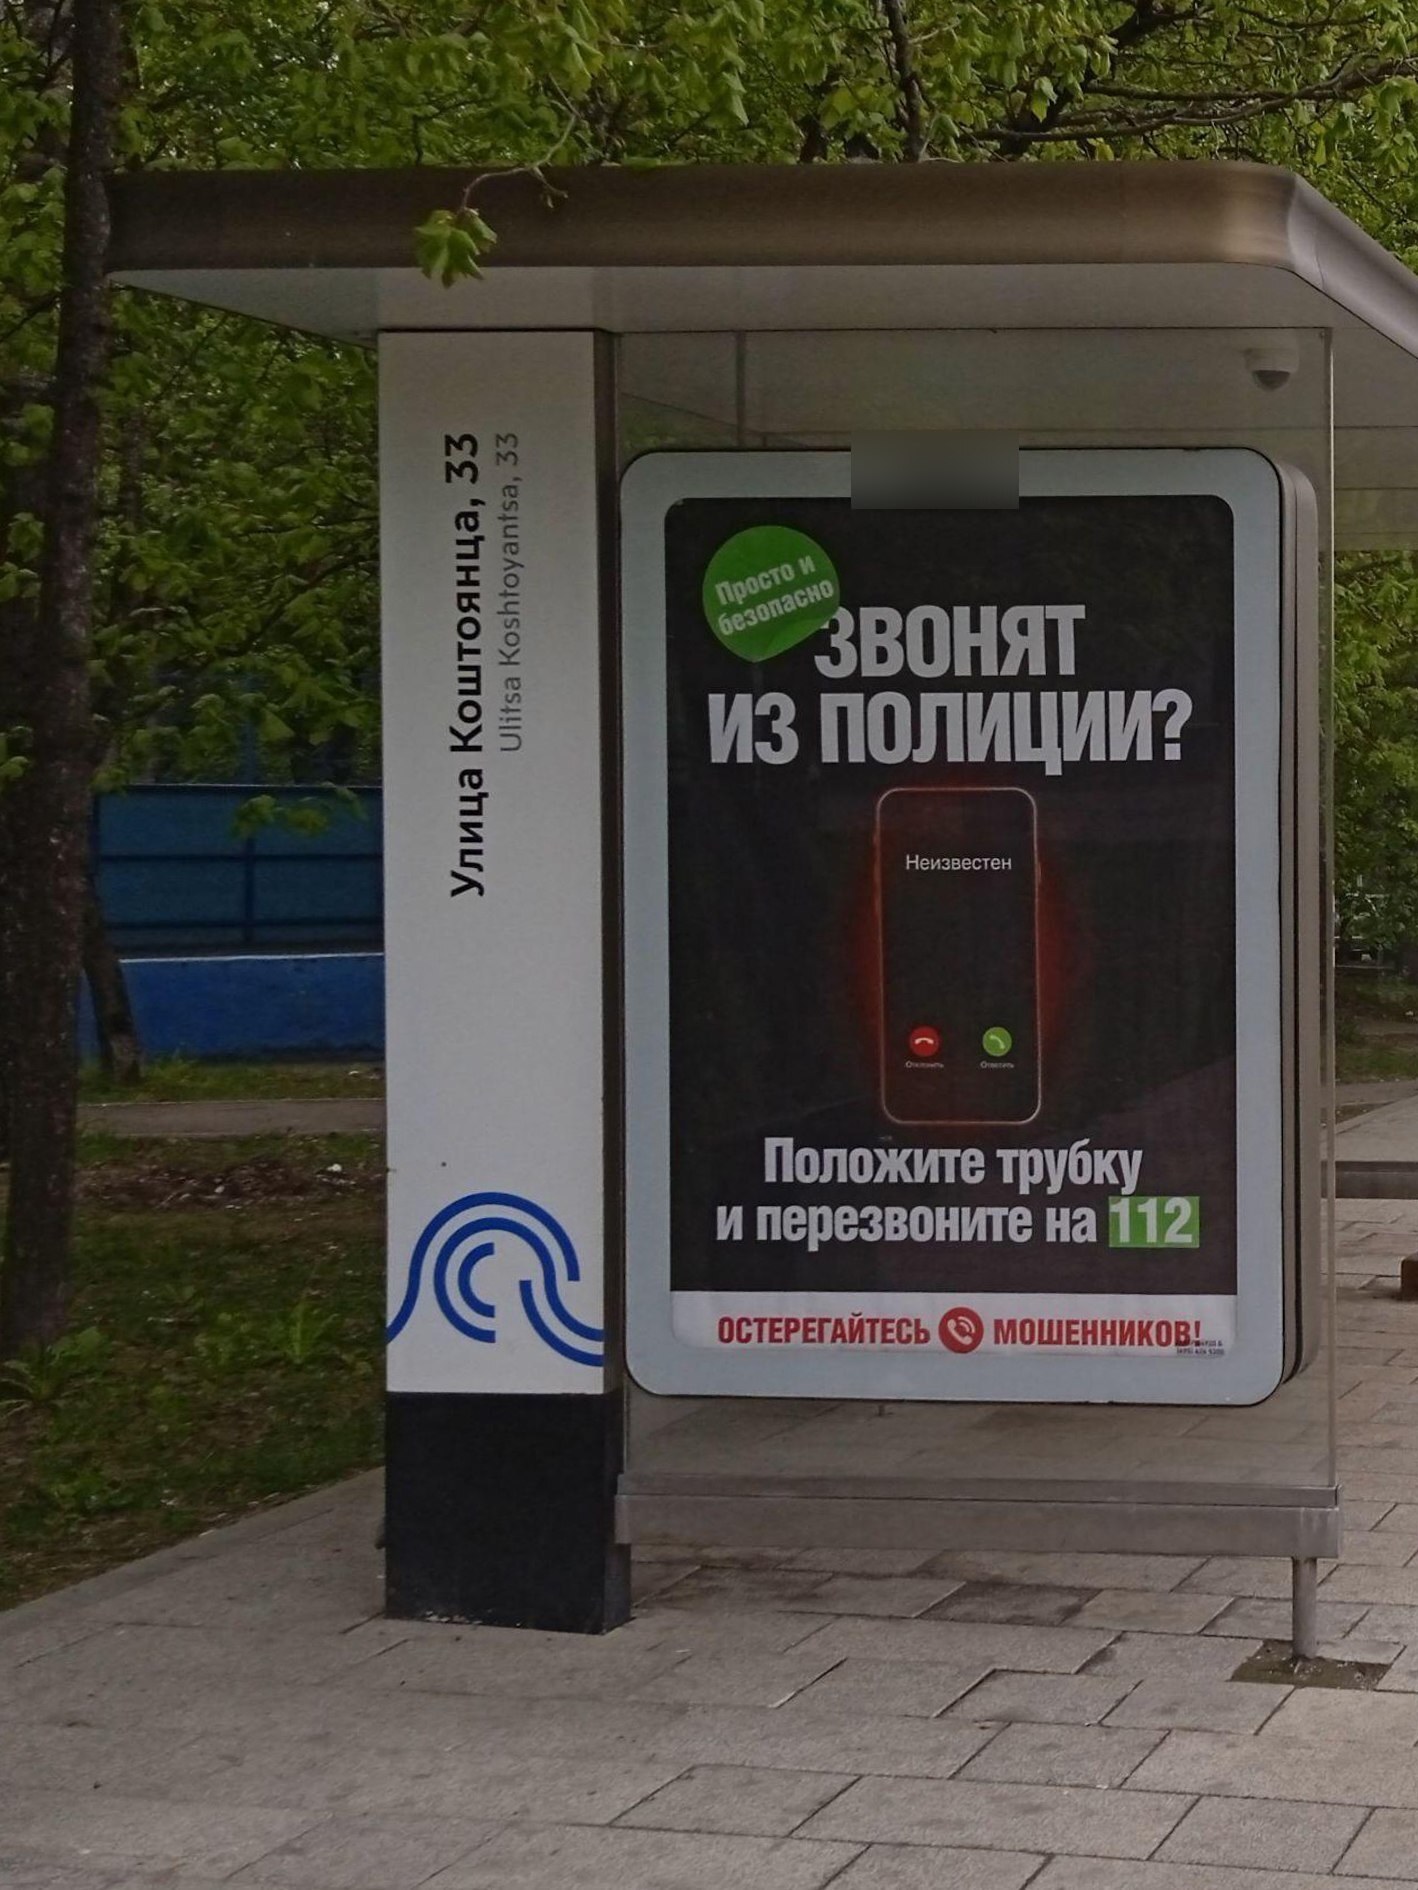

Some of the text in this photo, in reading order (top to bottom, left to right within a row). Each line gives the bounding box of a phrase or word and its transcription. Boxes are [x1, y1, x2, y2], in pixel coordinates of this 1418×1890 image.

[495, 432, 525, 752] Ulitsa Koshtoyantsa, 33
[715, 555, 816, 606] Просто и
[717, 580, 834, 635] безопасно
[445, 433, 489, 898] Улица Коштоянца, 33
[813, 604, 1086, 678] ЗВОНЯТ
[707, 688, 1193, 775] ИЗ ПОЛИЦИИ?
[905, 854, 1012, 871] Неизвестен
[764, 1137, 1143, 1196] Положите трубку
[716, 1197, 1194, 1252] и перезвоните на 112
[718, 1310, 1201, 1347] ОСТЕРЕГАЙТЕСЬ МОШЕННИКОВ!
